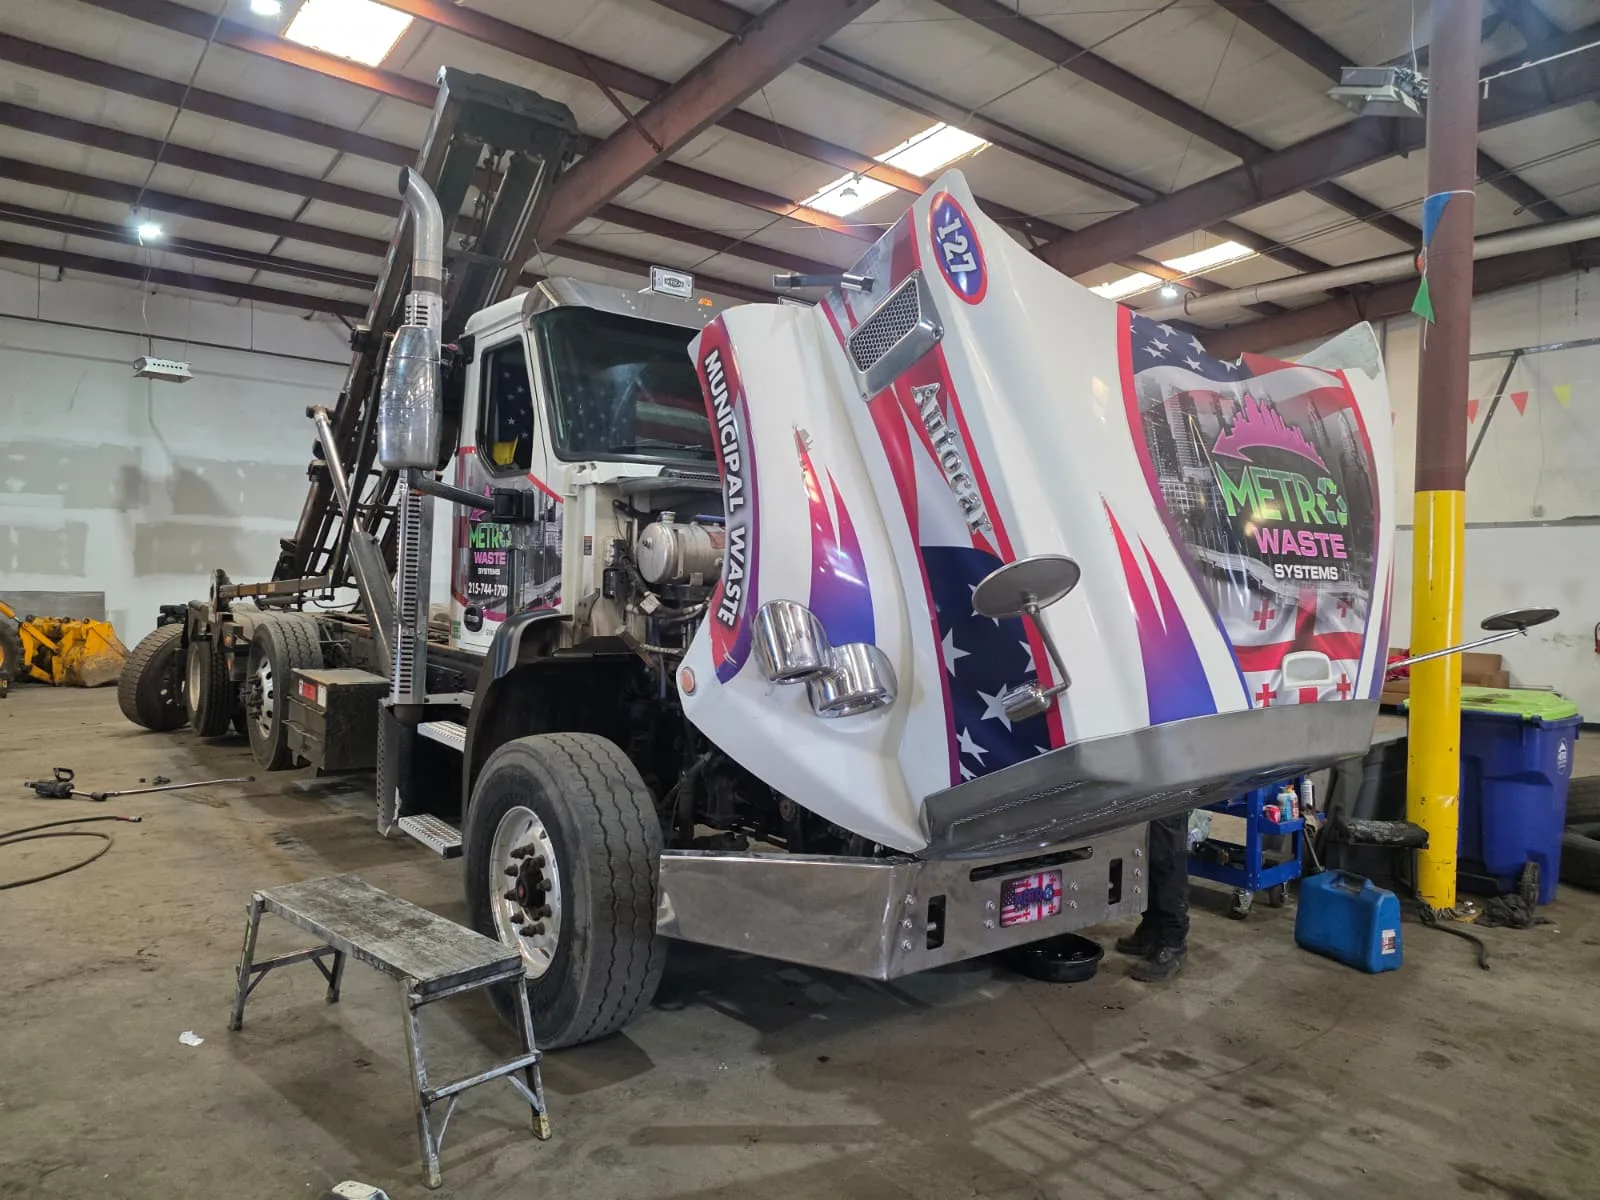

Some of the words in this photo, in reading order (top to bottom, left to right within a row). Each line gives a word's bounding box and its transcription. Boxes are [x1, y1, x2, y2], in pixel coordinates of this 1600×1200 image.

[938, 217, 977, 274] 127
[704, 349, 744, 513] MUNICIPAL
[911, 382, 993, 536] Autocar
[1215, 461, 1348, 528] METRO
[468, 522, 513, 549] METRO
[473, 551, 507, 565] WASTE
[1253, 527, 1348, 559] WASTE
[716, 526, 746, 627] WASTE
[1274, 563, 1339, 580] SYSTEMS
